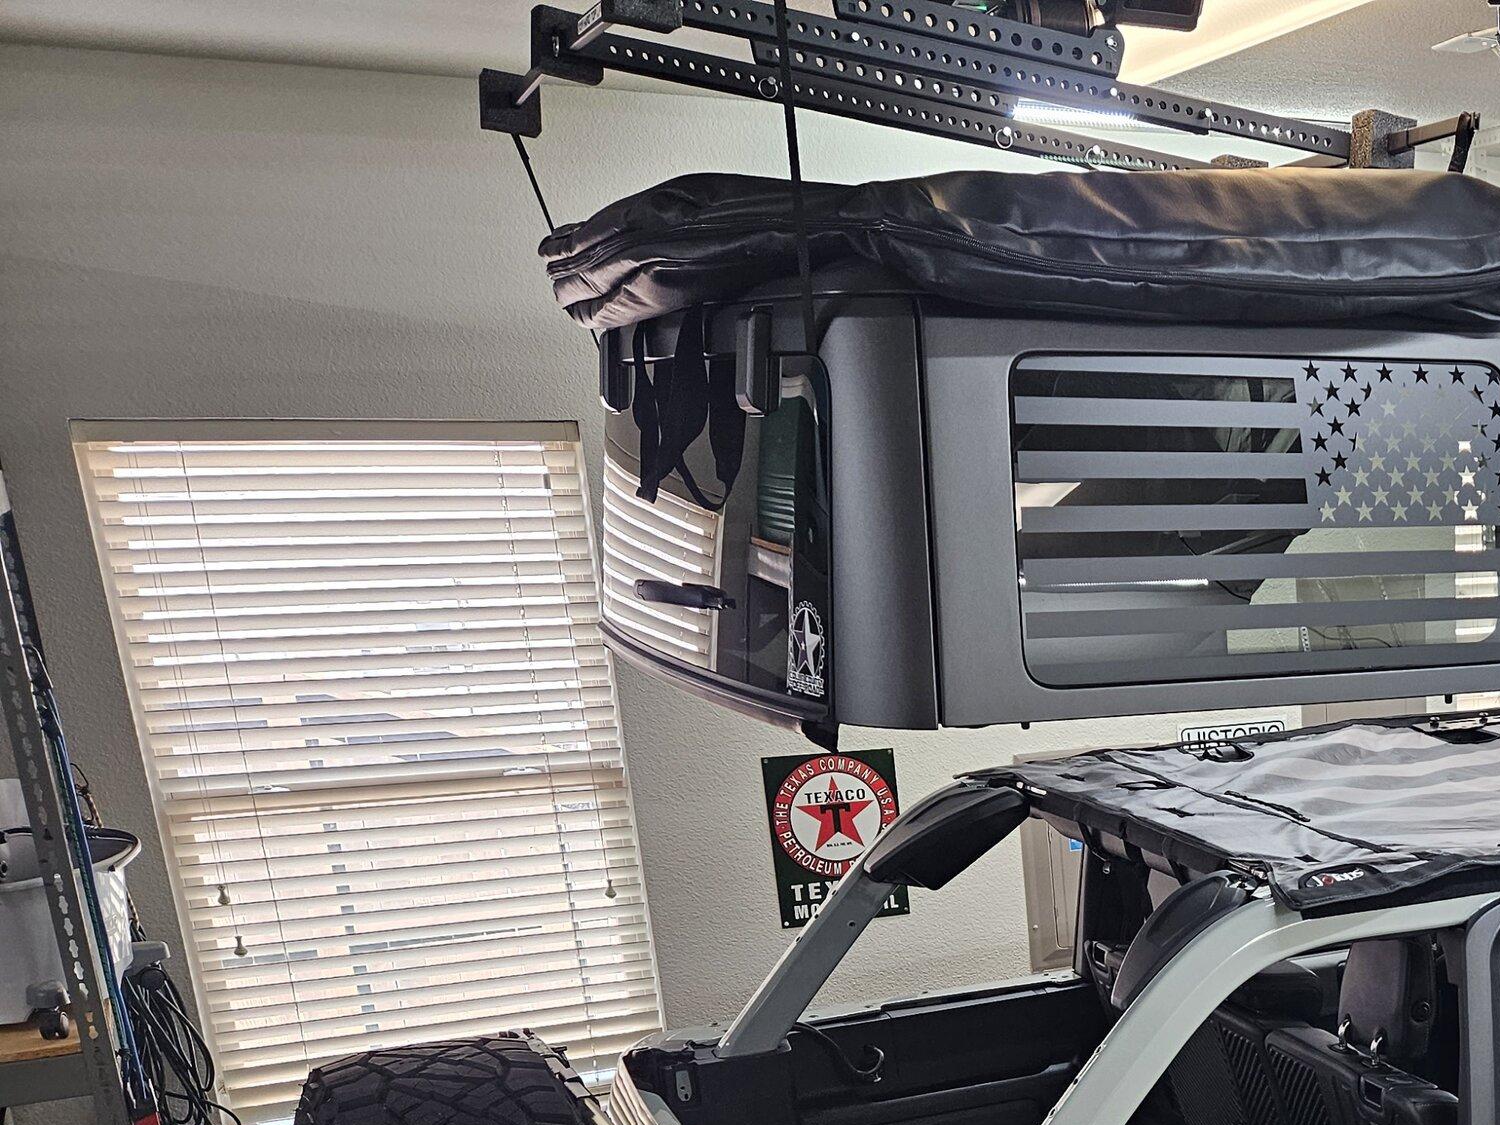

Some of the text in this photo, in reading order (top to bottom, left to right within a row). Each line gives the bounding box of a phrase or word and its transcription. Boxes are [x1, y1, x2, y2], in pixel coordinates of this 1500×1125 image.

[780, 763, 815, 798] TEXAS
[819, 757, 880, 785] COMPANY
[804, 788, 866, 804] TEXACO
[775, 802, 789, 826] THE
[779, 831, 842, 875] PETROLEUM
[791, 880, 839, 902] TEX
[883, 894, 899, 910] IL
